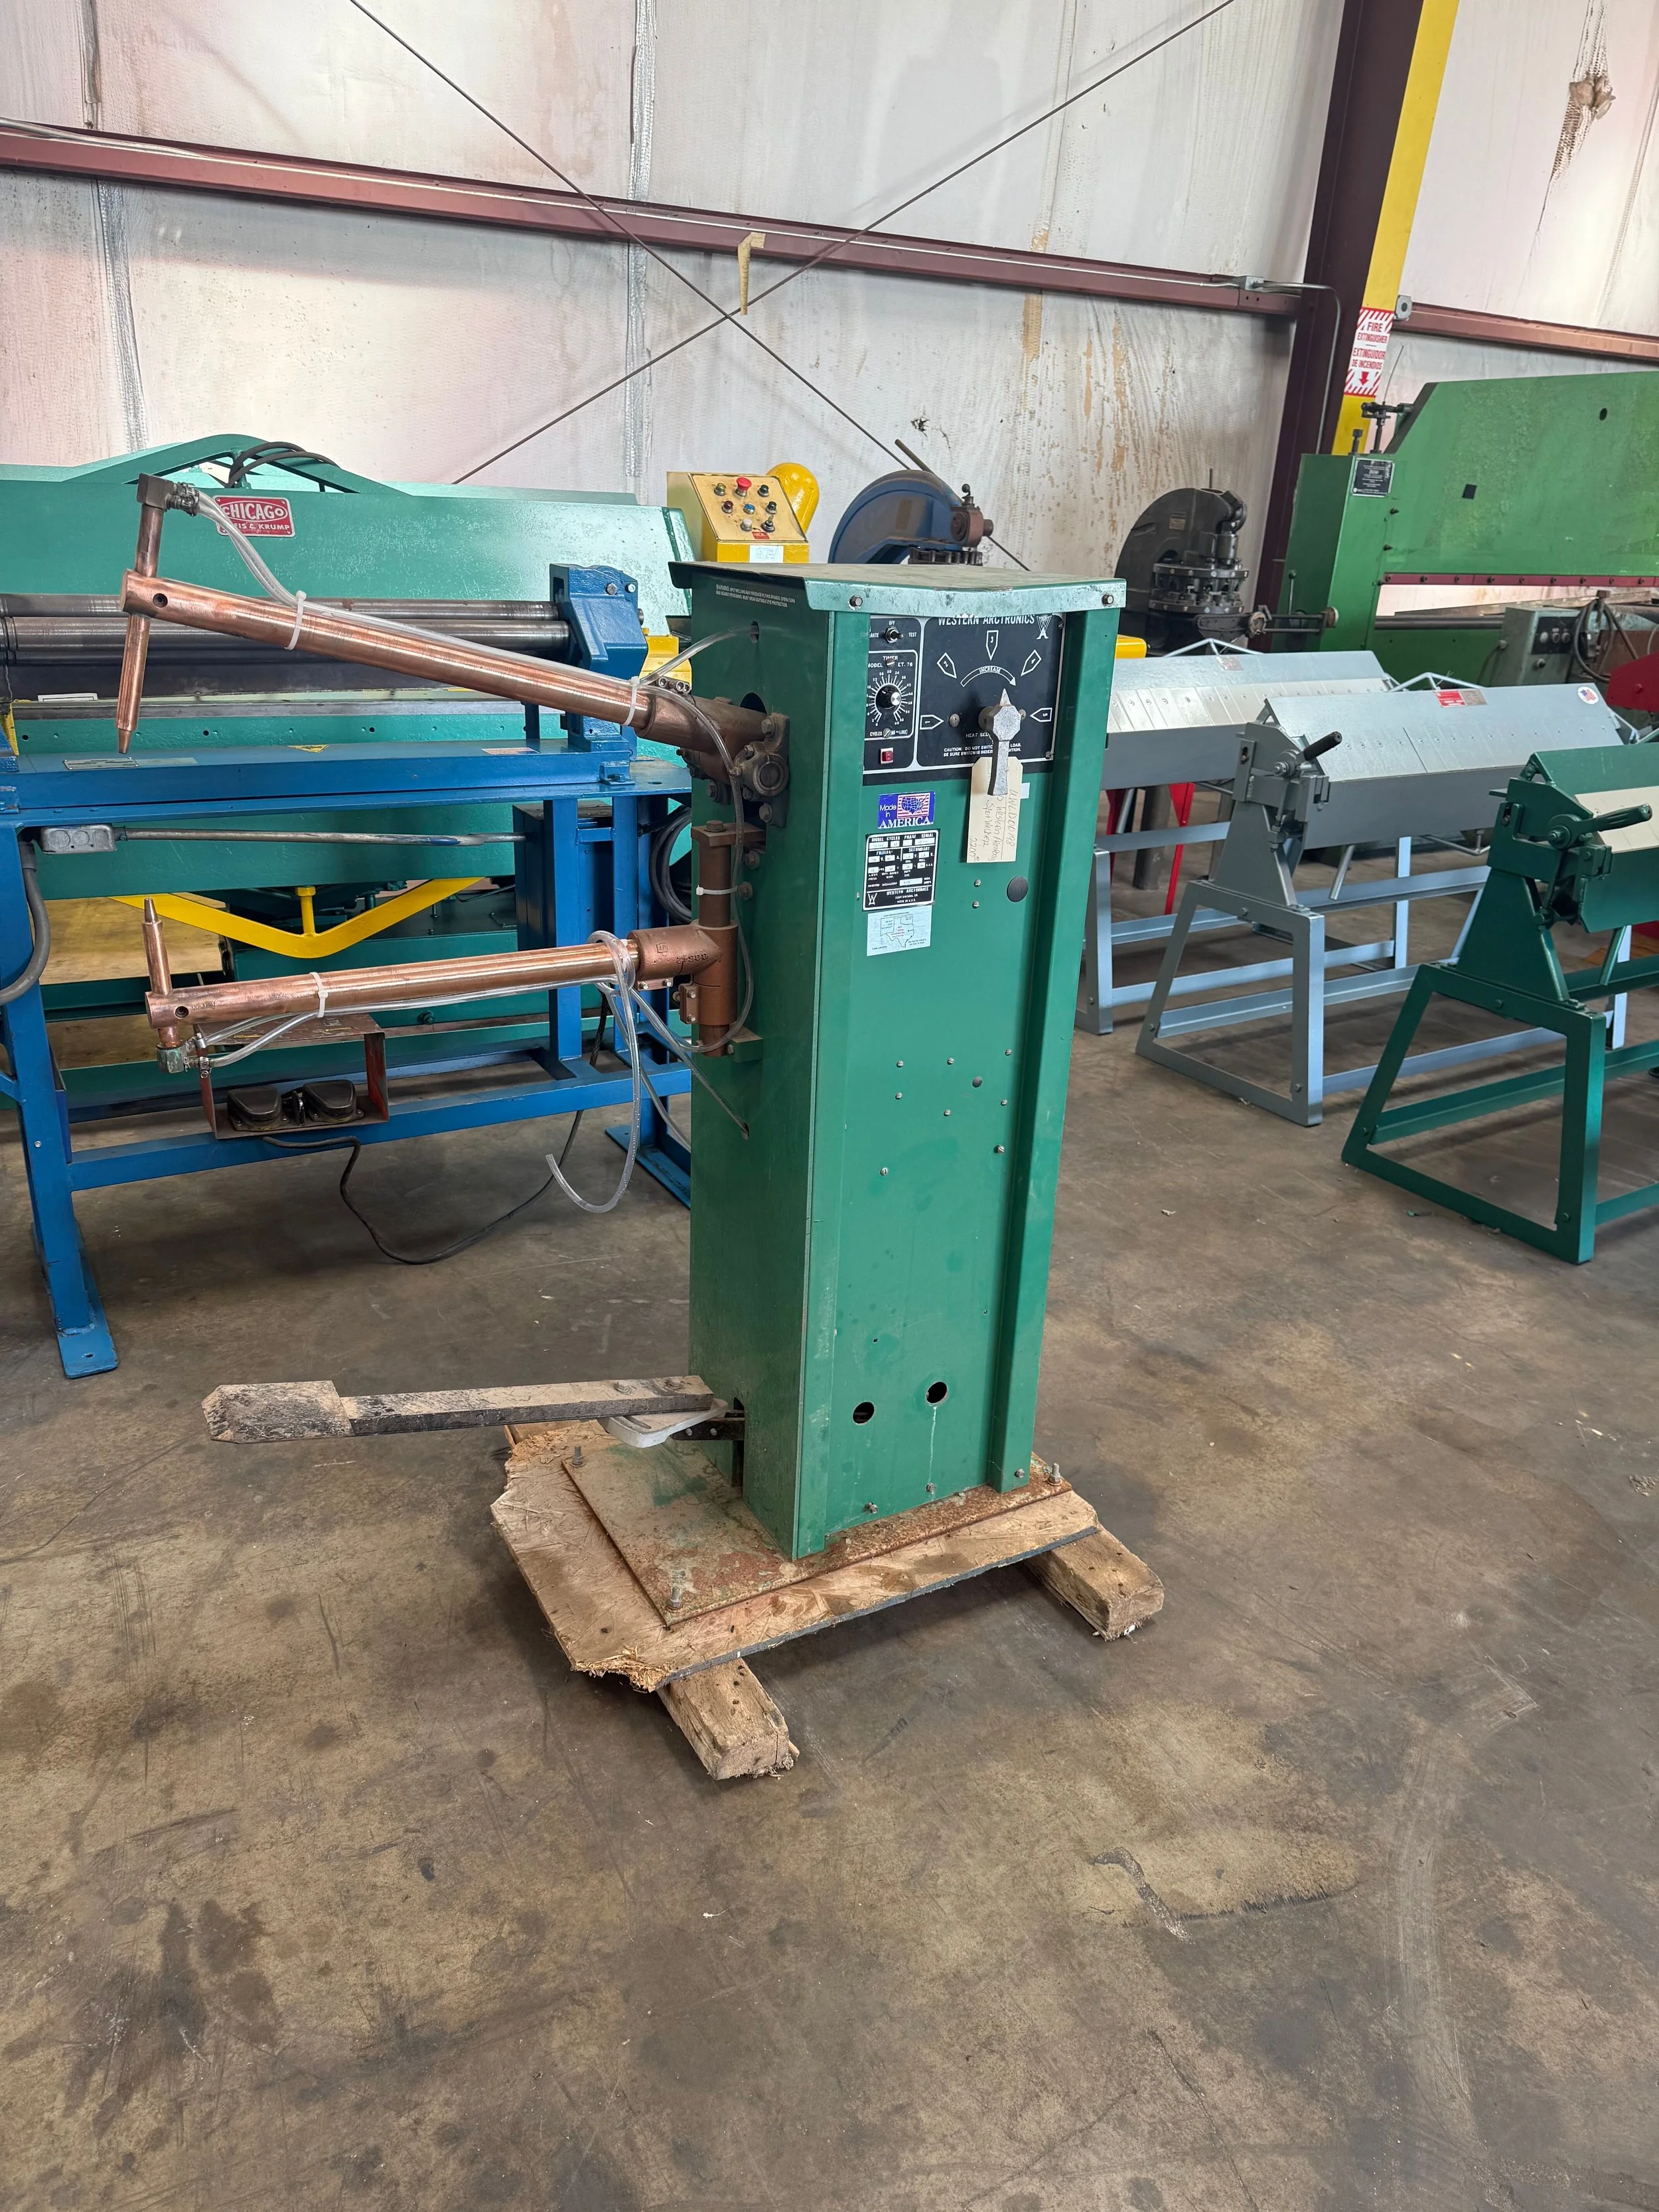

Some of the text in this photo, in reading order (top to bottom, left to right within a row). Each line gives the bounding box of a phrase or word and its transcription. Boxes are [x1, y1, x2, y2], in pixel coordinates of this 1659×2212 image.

[1367, 321, 1383, 332] FIRE
[1358, 332, 1387, 343] EXTINGUISHER
[222, 503, 284, 520] CHICAGO
[938, 615, 1035, 626] WESTERN ARCTRONICS
[878, 816, 932, 829] AMERICA
